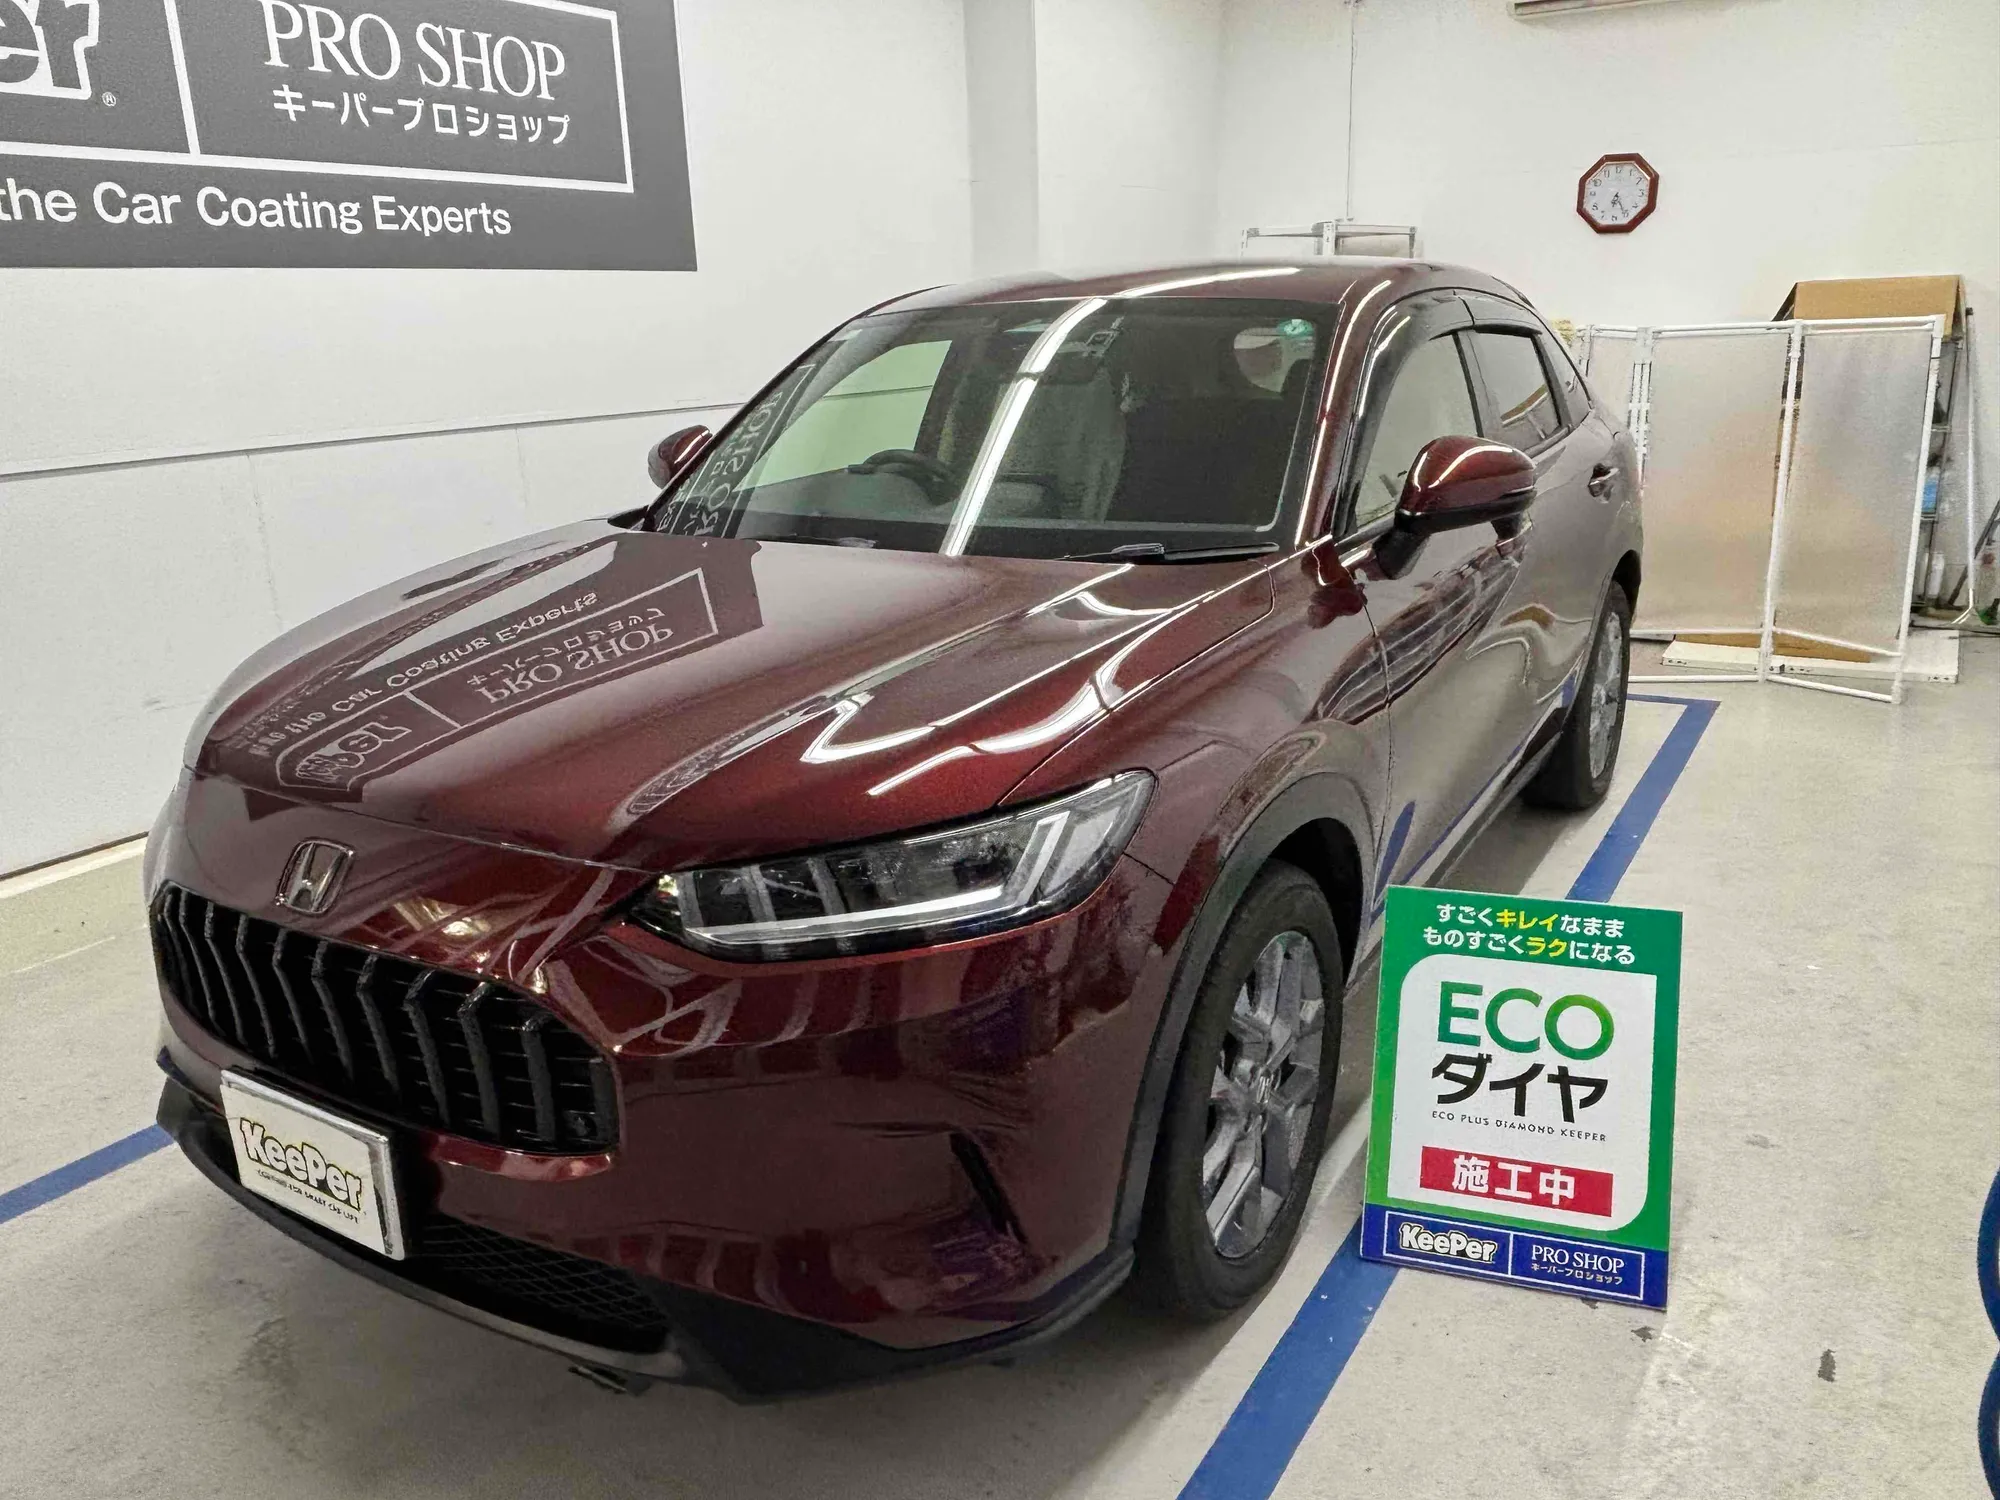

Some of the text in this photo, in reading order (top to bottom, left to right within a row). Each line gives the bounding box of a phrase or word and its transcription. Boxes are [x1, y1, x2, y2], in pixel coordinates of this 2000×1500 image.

[258, 0, 566, 101] PRO SHOP
[272, 84, 570, 144] キーパープロショップ
[93, 181, 181, 224] Car
[196, 185, 363, 235] Coating
[372, 194, 512, 237] Experts
[1423, 926, 1636, 965] ものすごくラクになる
[1436, 903, 1625, 938] すごくキレイなまま
[1437, 981, 1615, 1061] ECO
[1431, 1052, 1609, 1123] ダイヤ
[1432, 1110, 1607, 1142] ECO PLUS DIAMOND KEEPER
[239, 1117, 363, 1212] KeePer
[1452, 1154, 1576, 1206] 施工中
[1399, 1222, 1498, 1264] KeePer
[1531, 1245, 1625, 1274] PRO SHOP
